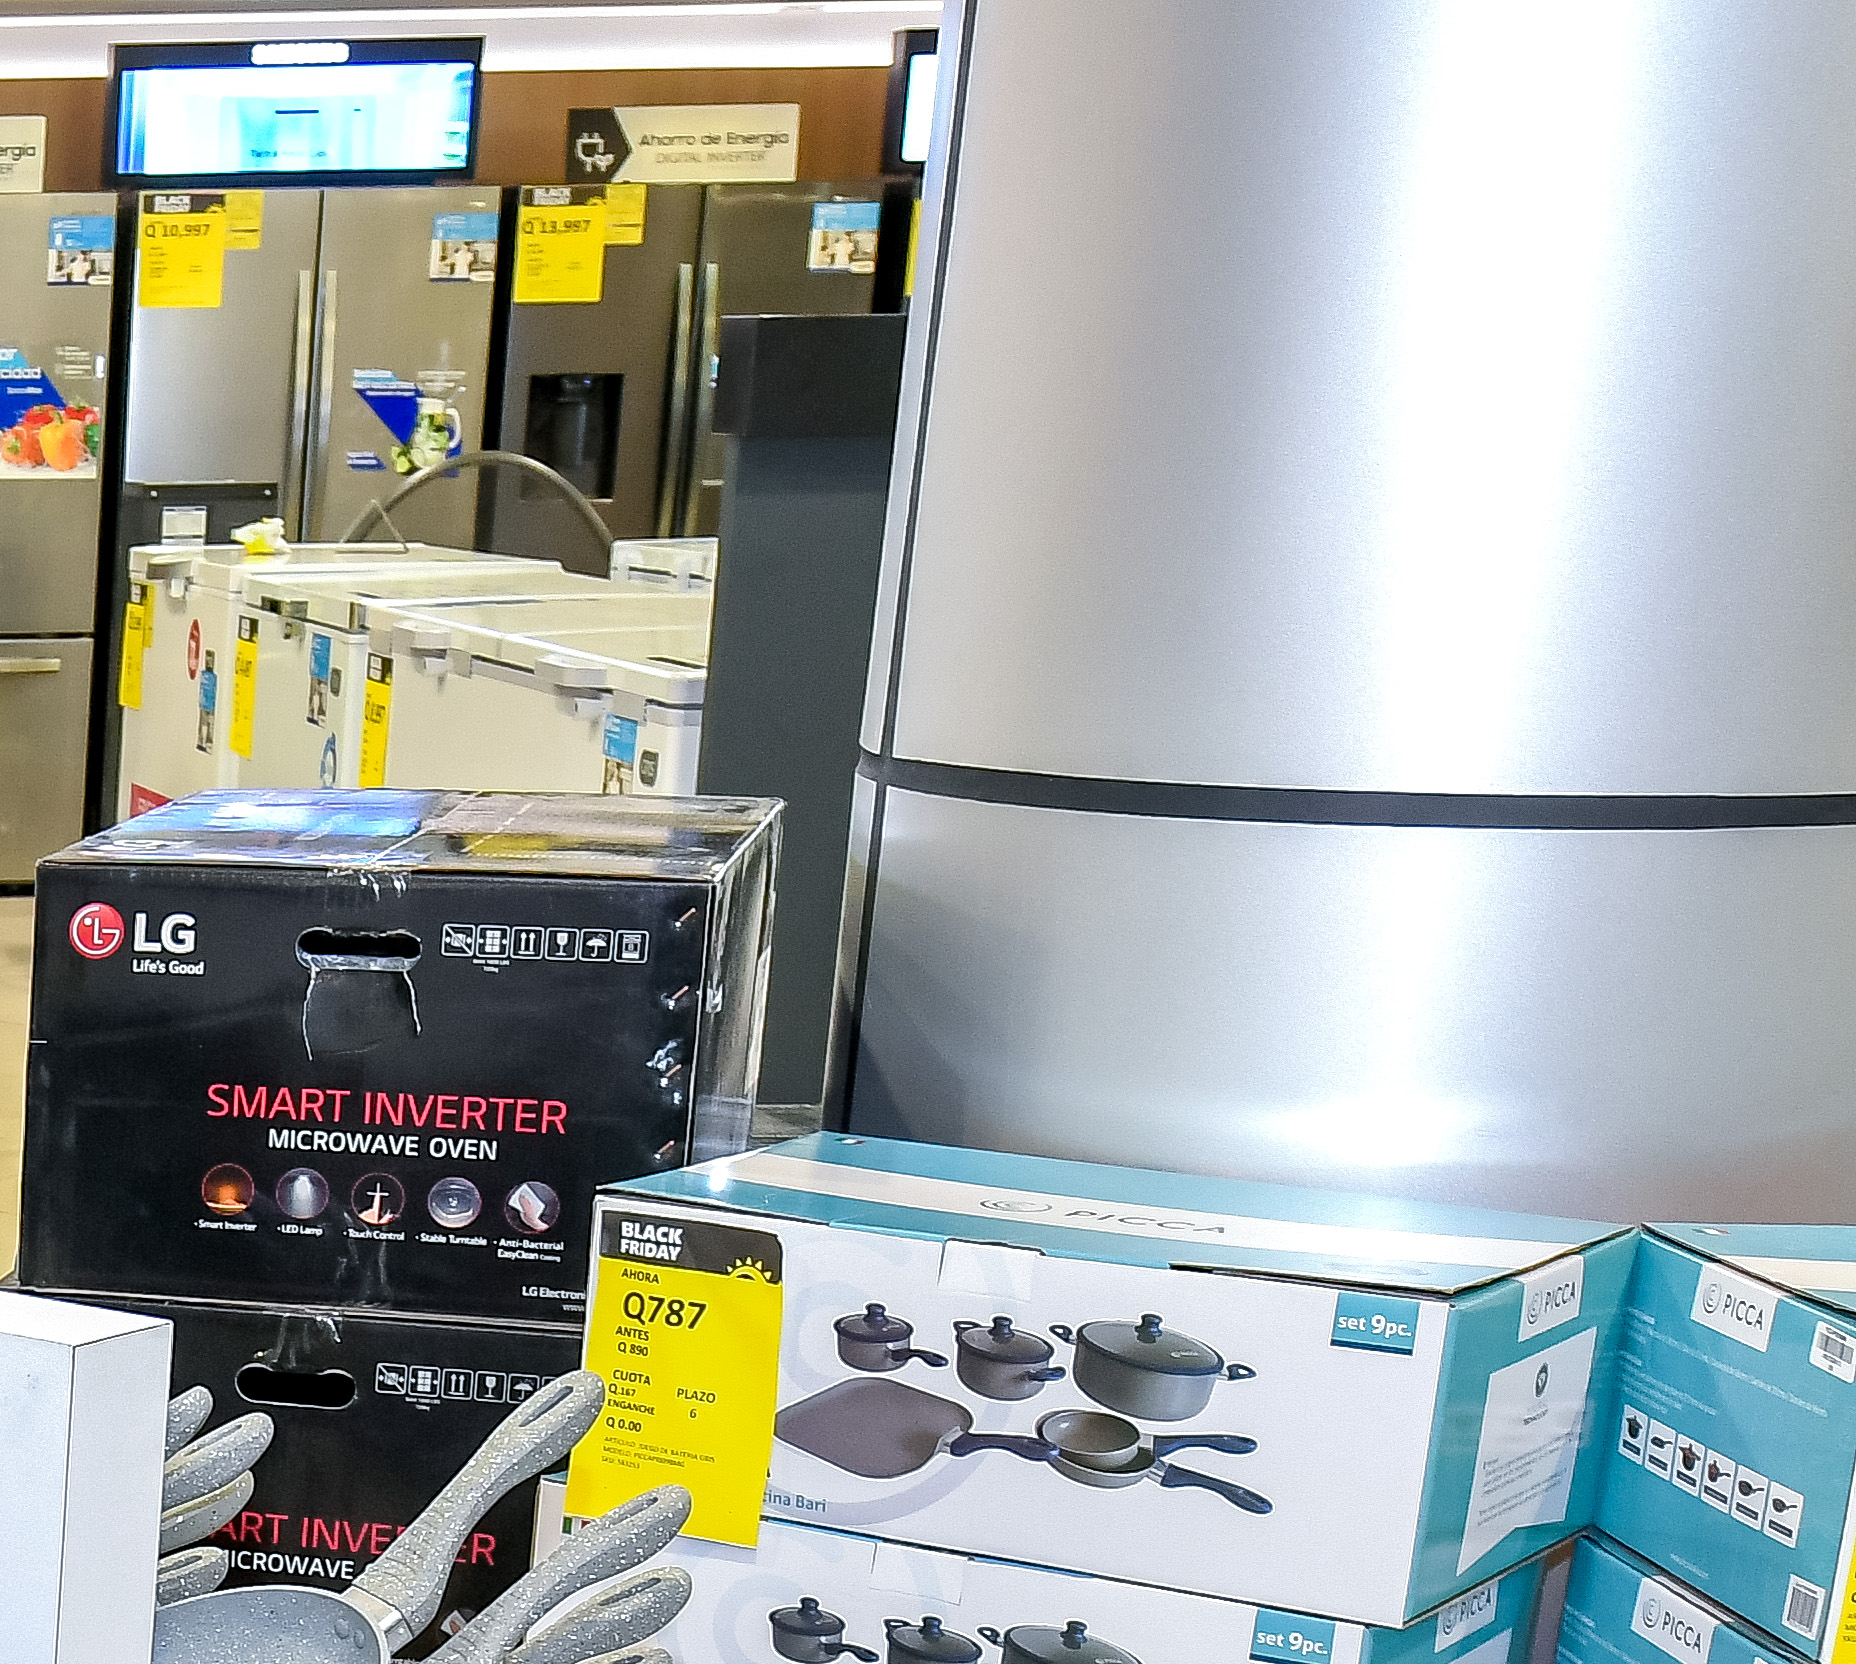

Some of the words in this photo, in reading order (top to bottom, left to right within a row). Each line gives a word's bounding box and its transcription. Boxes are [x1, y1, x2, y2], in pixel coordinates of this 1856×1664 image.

[132, 911, 197, 954] LG
[131, 959, 166, 974] Life's
[168, 961, 205, 976] Good
[206, 1083, 350, 1124] SMART
[363, 1089, 568, 1136] INVERTER
[267, 1128, 420, 1158] MICROWAVE
[428, 1136, 498, 1161] OVEN
[198, 1218, 224, 1231] Smart
[1064, 1207, 1230, 1235] PICCA
[281, 1224, 298, 1235] LED
[299, 1226, 324, 1238] Lamp
[348, 1228, 371, 1240] Touch
[372, 1229, 406, 1241] Control
[620, 1221, 683, 1246] BLACK
[498, 1238, 565, 1252] Anti-Bacterial
[619, 1238, 682, 1263] FRIDAY
[620, 1267, 660, 1285] AHORA
[522, 1285, 538, 1298] LG
[1543, 1282, 1577, 1316] PICCA
[622, 1290, 707, 1330] Q787
[1722, 1293, 1765, 1331] PICCA
[615, 1326, 650, 1342] ANTES
[1336, 1313, 1369, 1334] set
[1370, 1313, 1413, 1338] 9pc.
[617, 1341, 627, 1355] Q
[613, 1369, 651, 1386] CUOTA
[676, 1387, 716, 1404] PLAZO
[607, 1398, 656, 1416] ENGANCHE
[689, 1408, 697, 1419] 6
[605, 1416, 615, 1429] Q
[617, 1418, 642, 1433] 0.00
[795, 1494, 826, 1512] Bari
[206, 1513, 289, 1545] ART
[224, 1549, 354, 1581] ICROWAVE
[1661, 1606, 1704, 1656] PICCA
[1256, 1628, 1286, 1649] set
[1288, 1630, 1329, 1658] 9pc.
